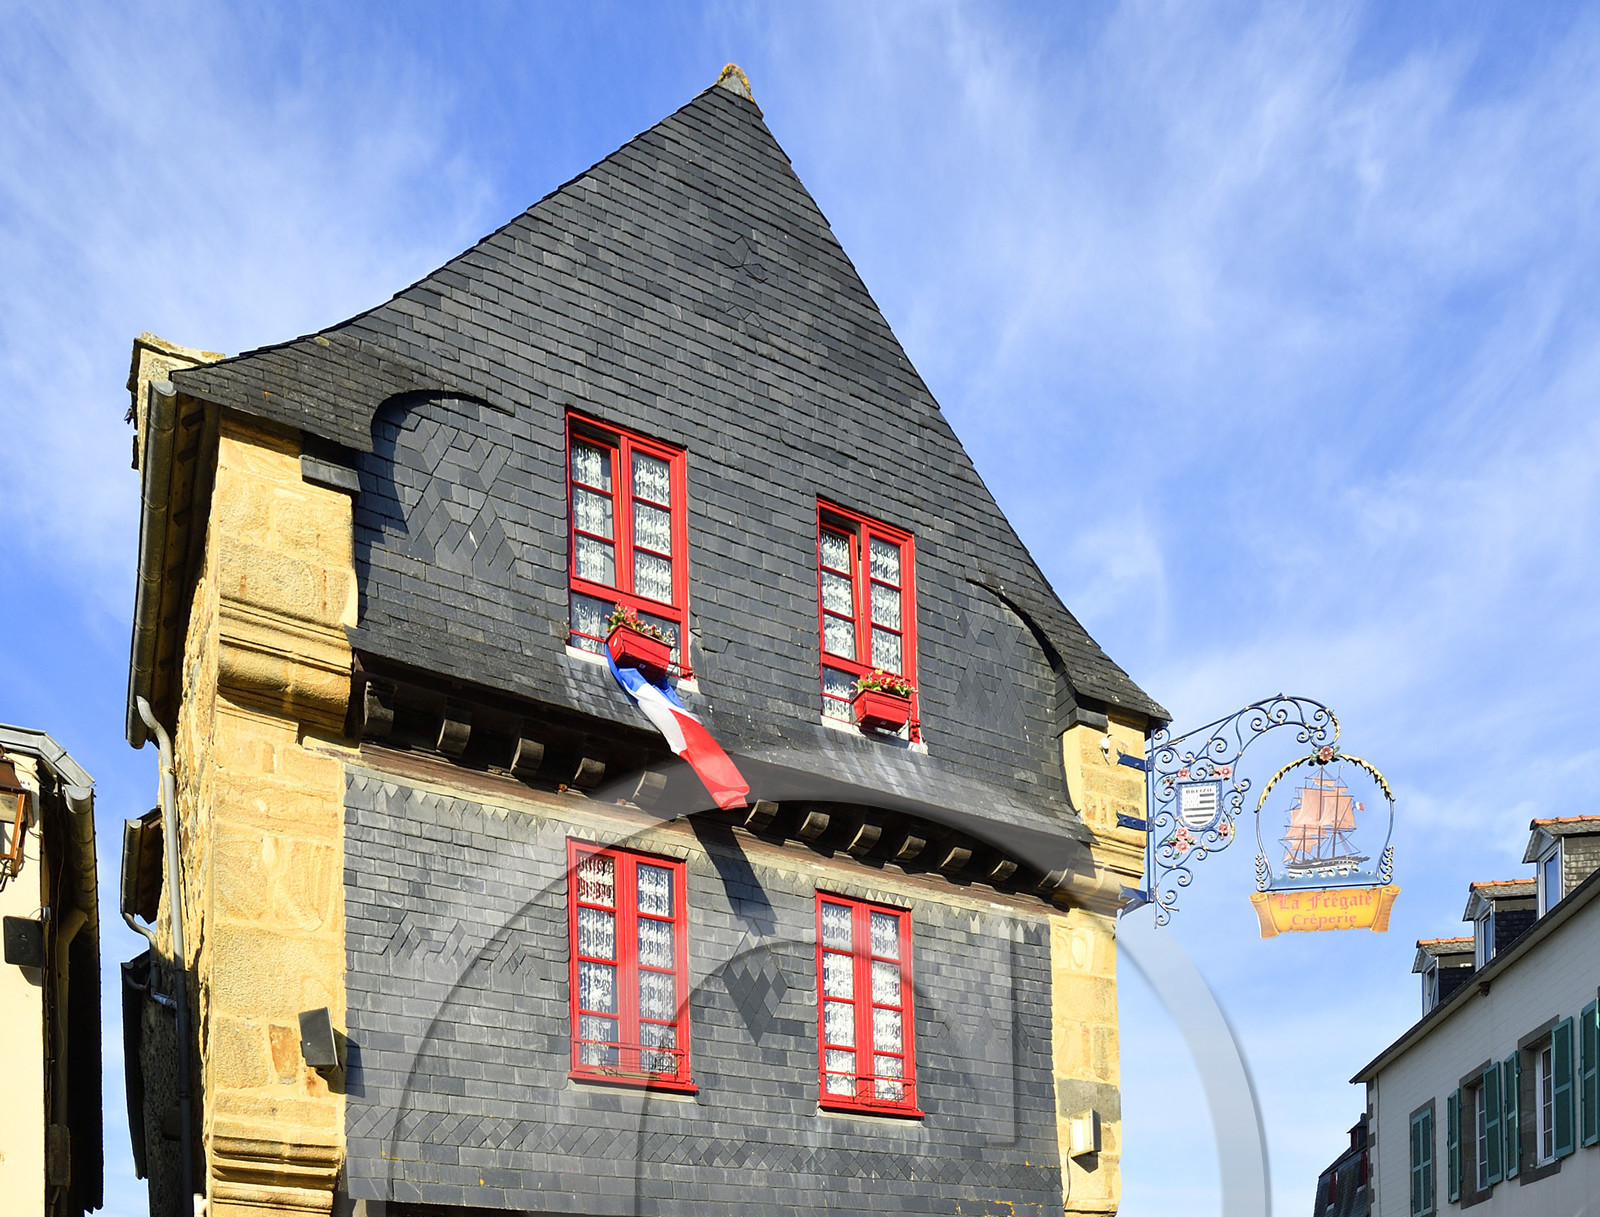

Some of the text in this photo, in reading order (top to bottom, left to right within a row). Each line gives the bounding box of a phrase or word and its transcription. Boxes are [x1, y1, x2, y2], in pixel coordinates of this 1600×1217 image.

[1277, 892, 1373, 912] La Frégate
[1291, 912, 1357, 929] Crêperie
